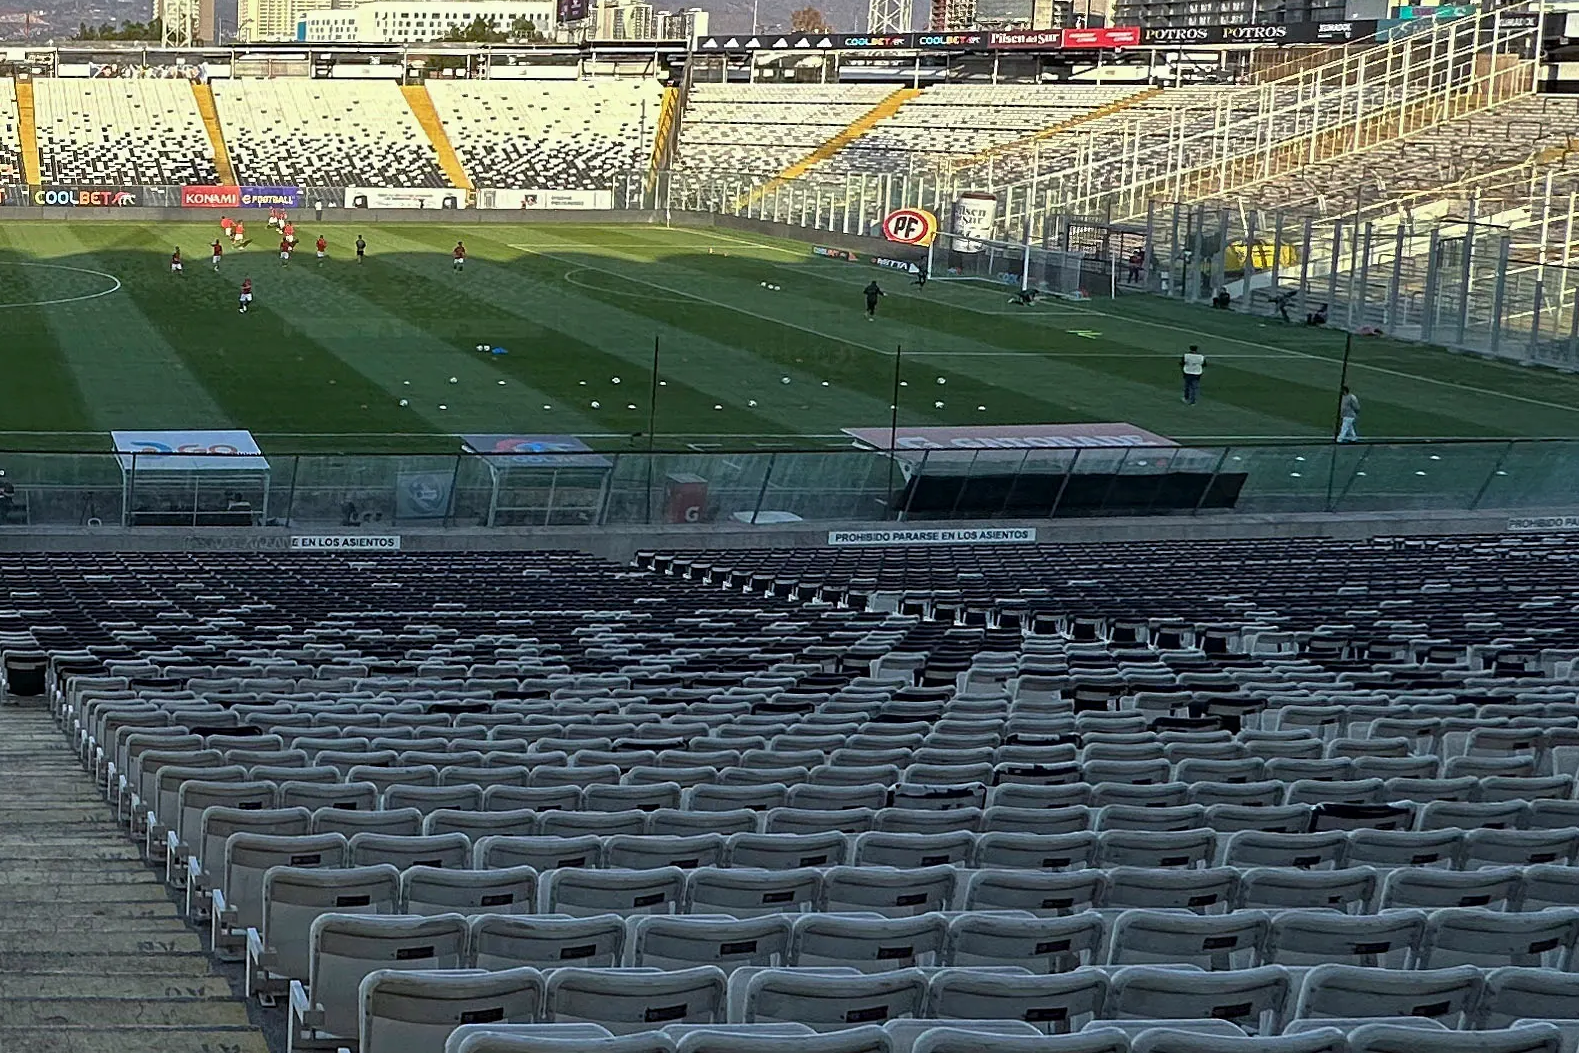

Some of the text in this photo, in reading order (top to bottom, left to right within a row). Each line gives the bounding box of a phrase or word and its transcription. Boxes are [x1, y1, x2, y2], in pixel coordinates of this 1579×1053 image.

[1146, 28, 1208, 40] POTROS
[1223, 26, 1287, 38] POTROS
[845, 37, 891, 46] COOLBET
[919, 36, 966, 45] COOLBET
[34, 190, 112, 204] COOLBET
[185, 193, 237, 204] KONAMI
[893, 216, 919, 238] PF
[301, 537, 316, 547] EN
[319, 537, 340, 547] LOS
[341, 537, 395, 547] ASIENTOS
[835, 530, 1029, 542] PROHIBIDO PARARSE EN LOS ASIENTOS
